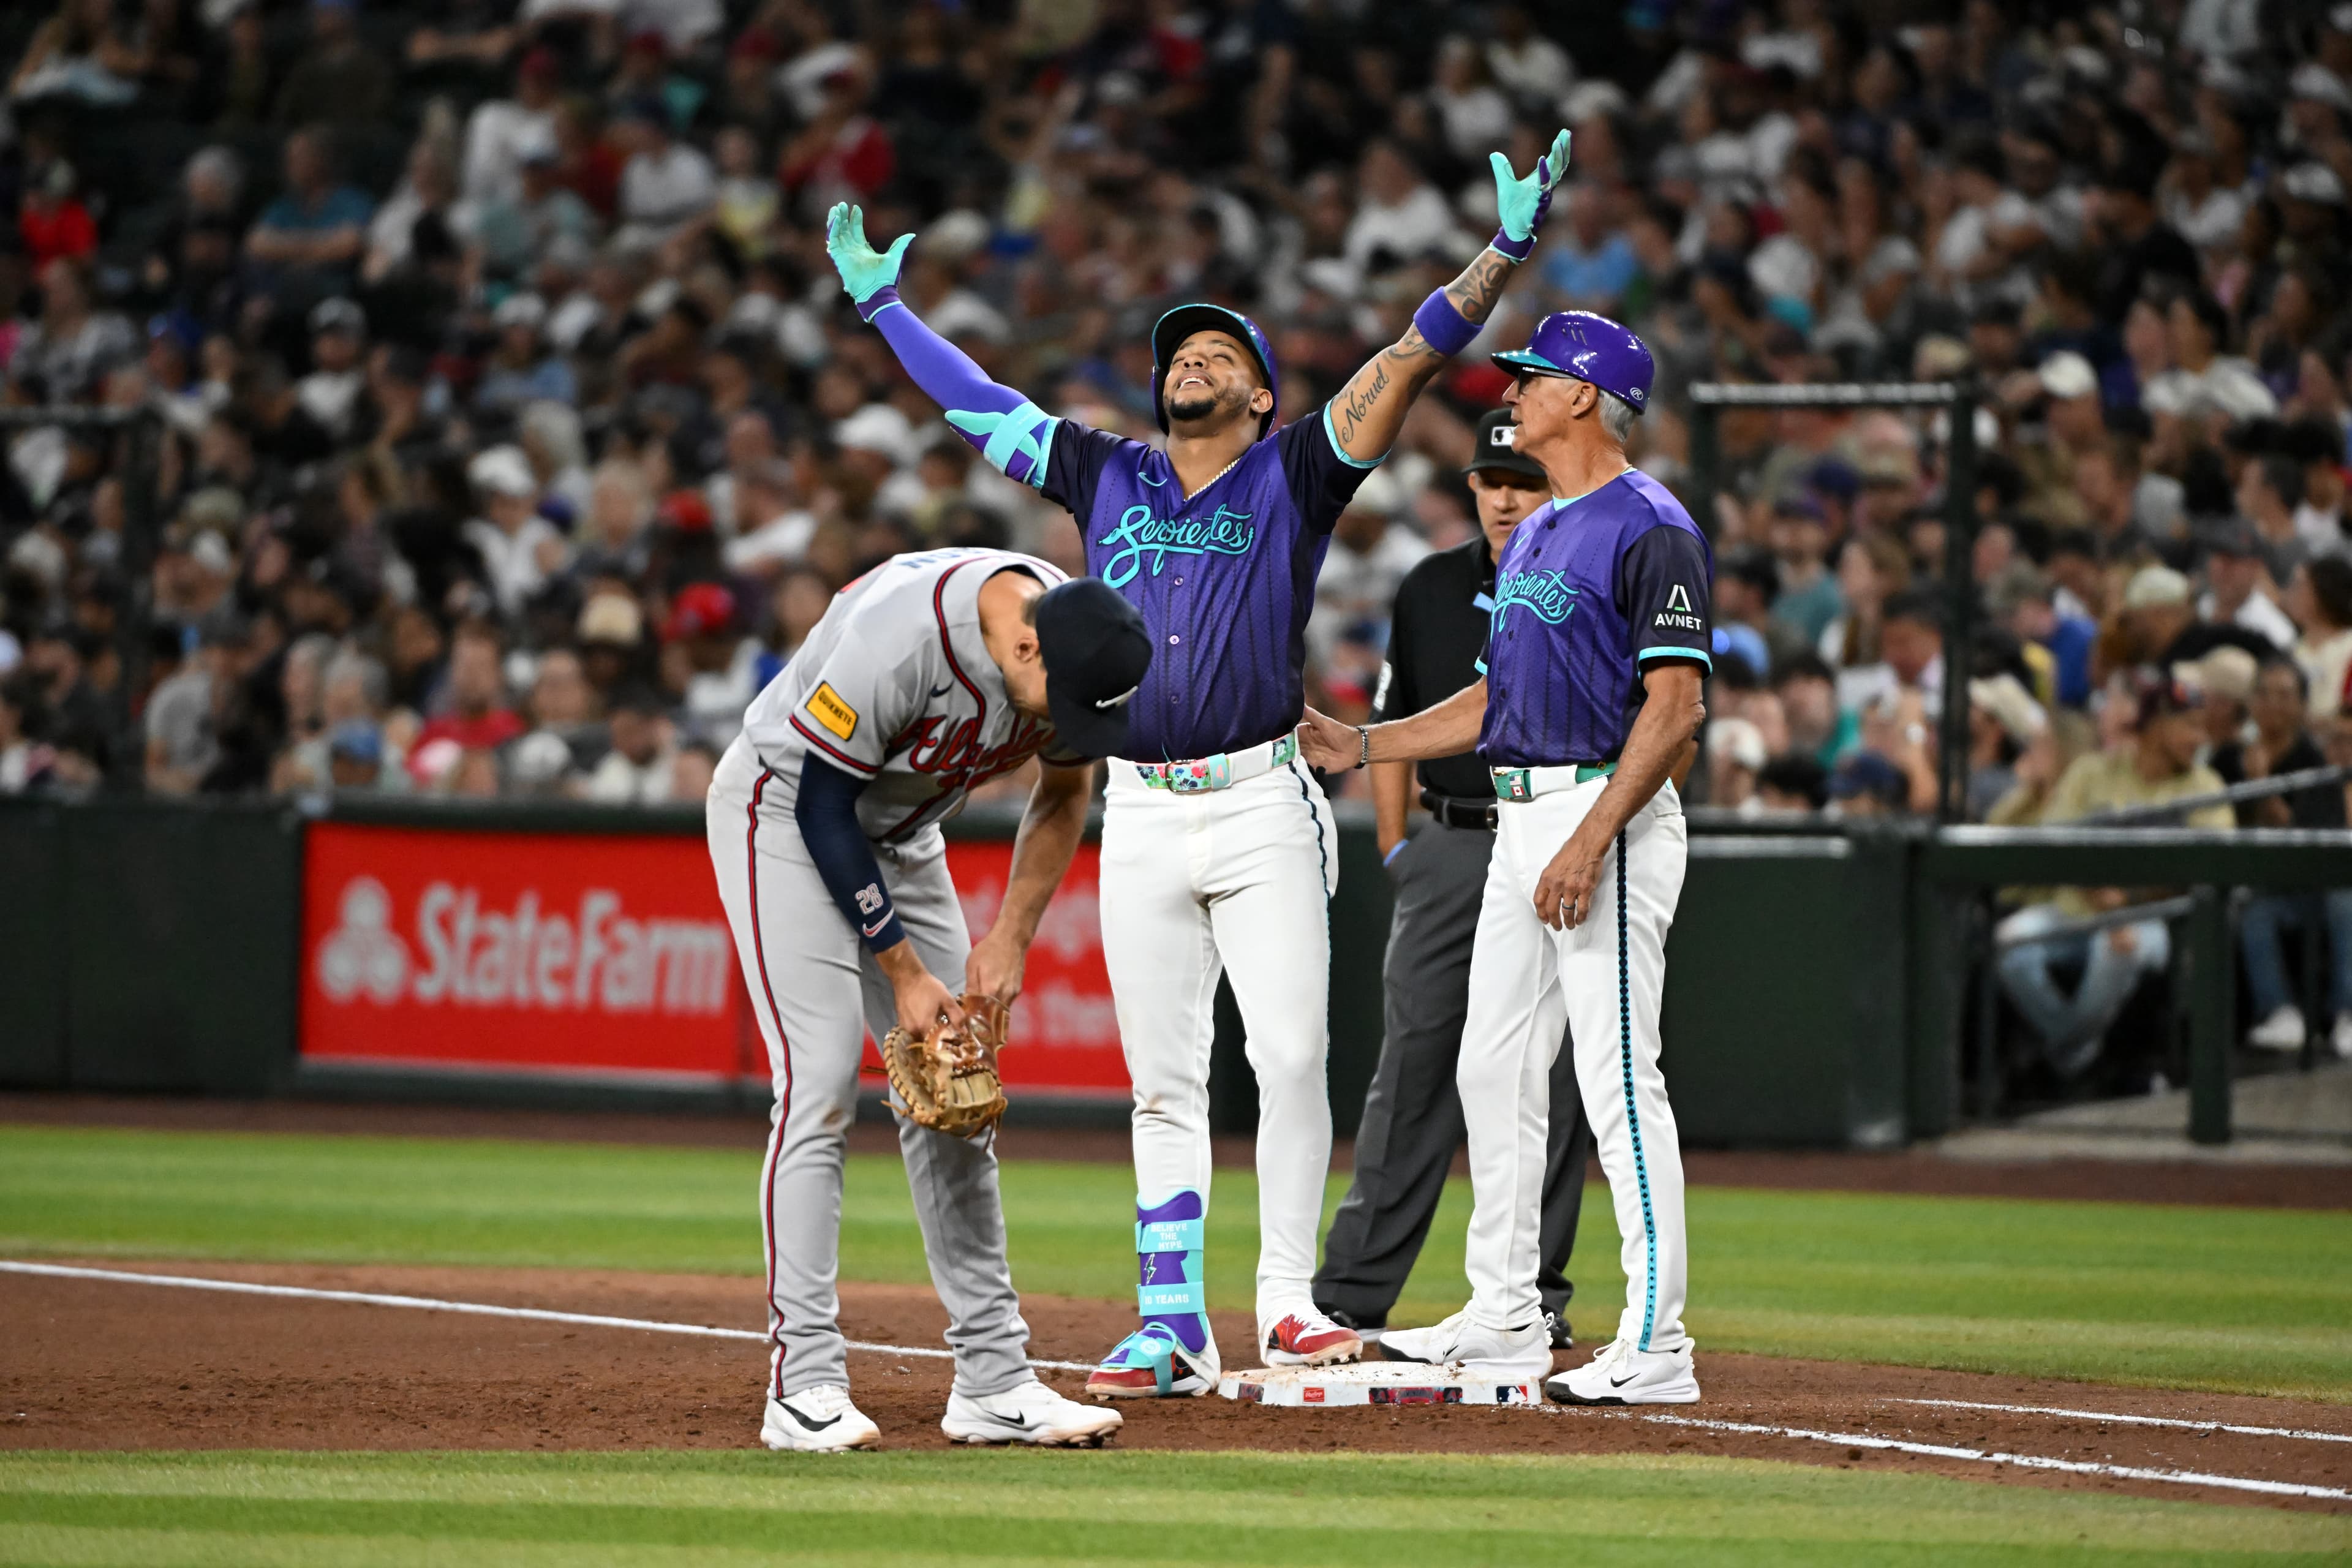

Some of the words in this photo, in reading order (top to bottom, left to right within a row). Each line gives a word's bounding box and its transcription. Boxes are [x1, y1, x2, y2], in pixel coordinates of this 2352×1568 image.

[1341, 362, 1390, 444] Noruel
[1655, 613, 1702, 630] AVNET
[855, 883, 883, 915] 28
[1152, 1223, 1187, 1232] BELIEVE
[1159, 1241, 1182, 1250] HYPE
[1156, 1294, 1189, 1303] YEARS
